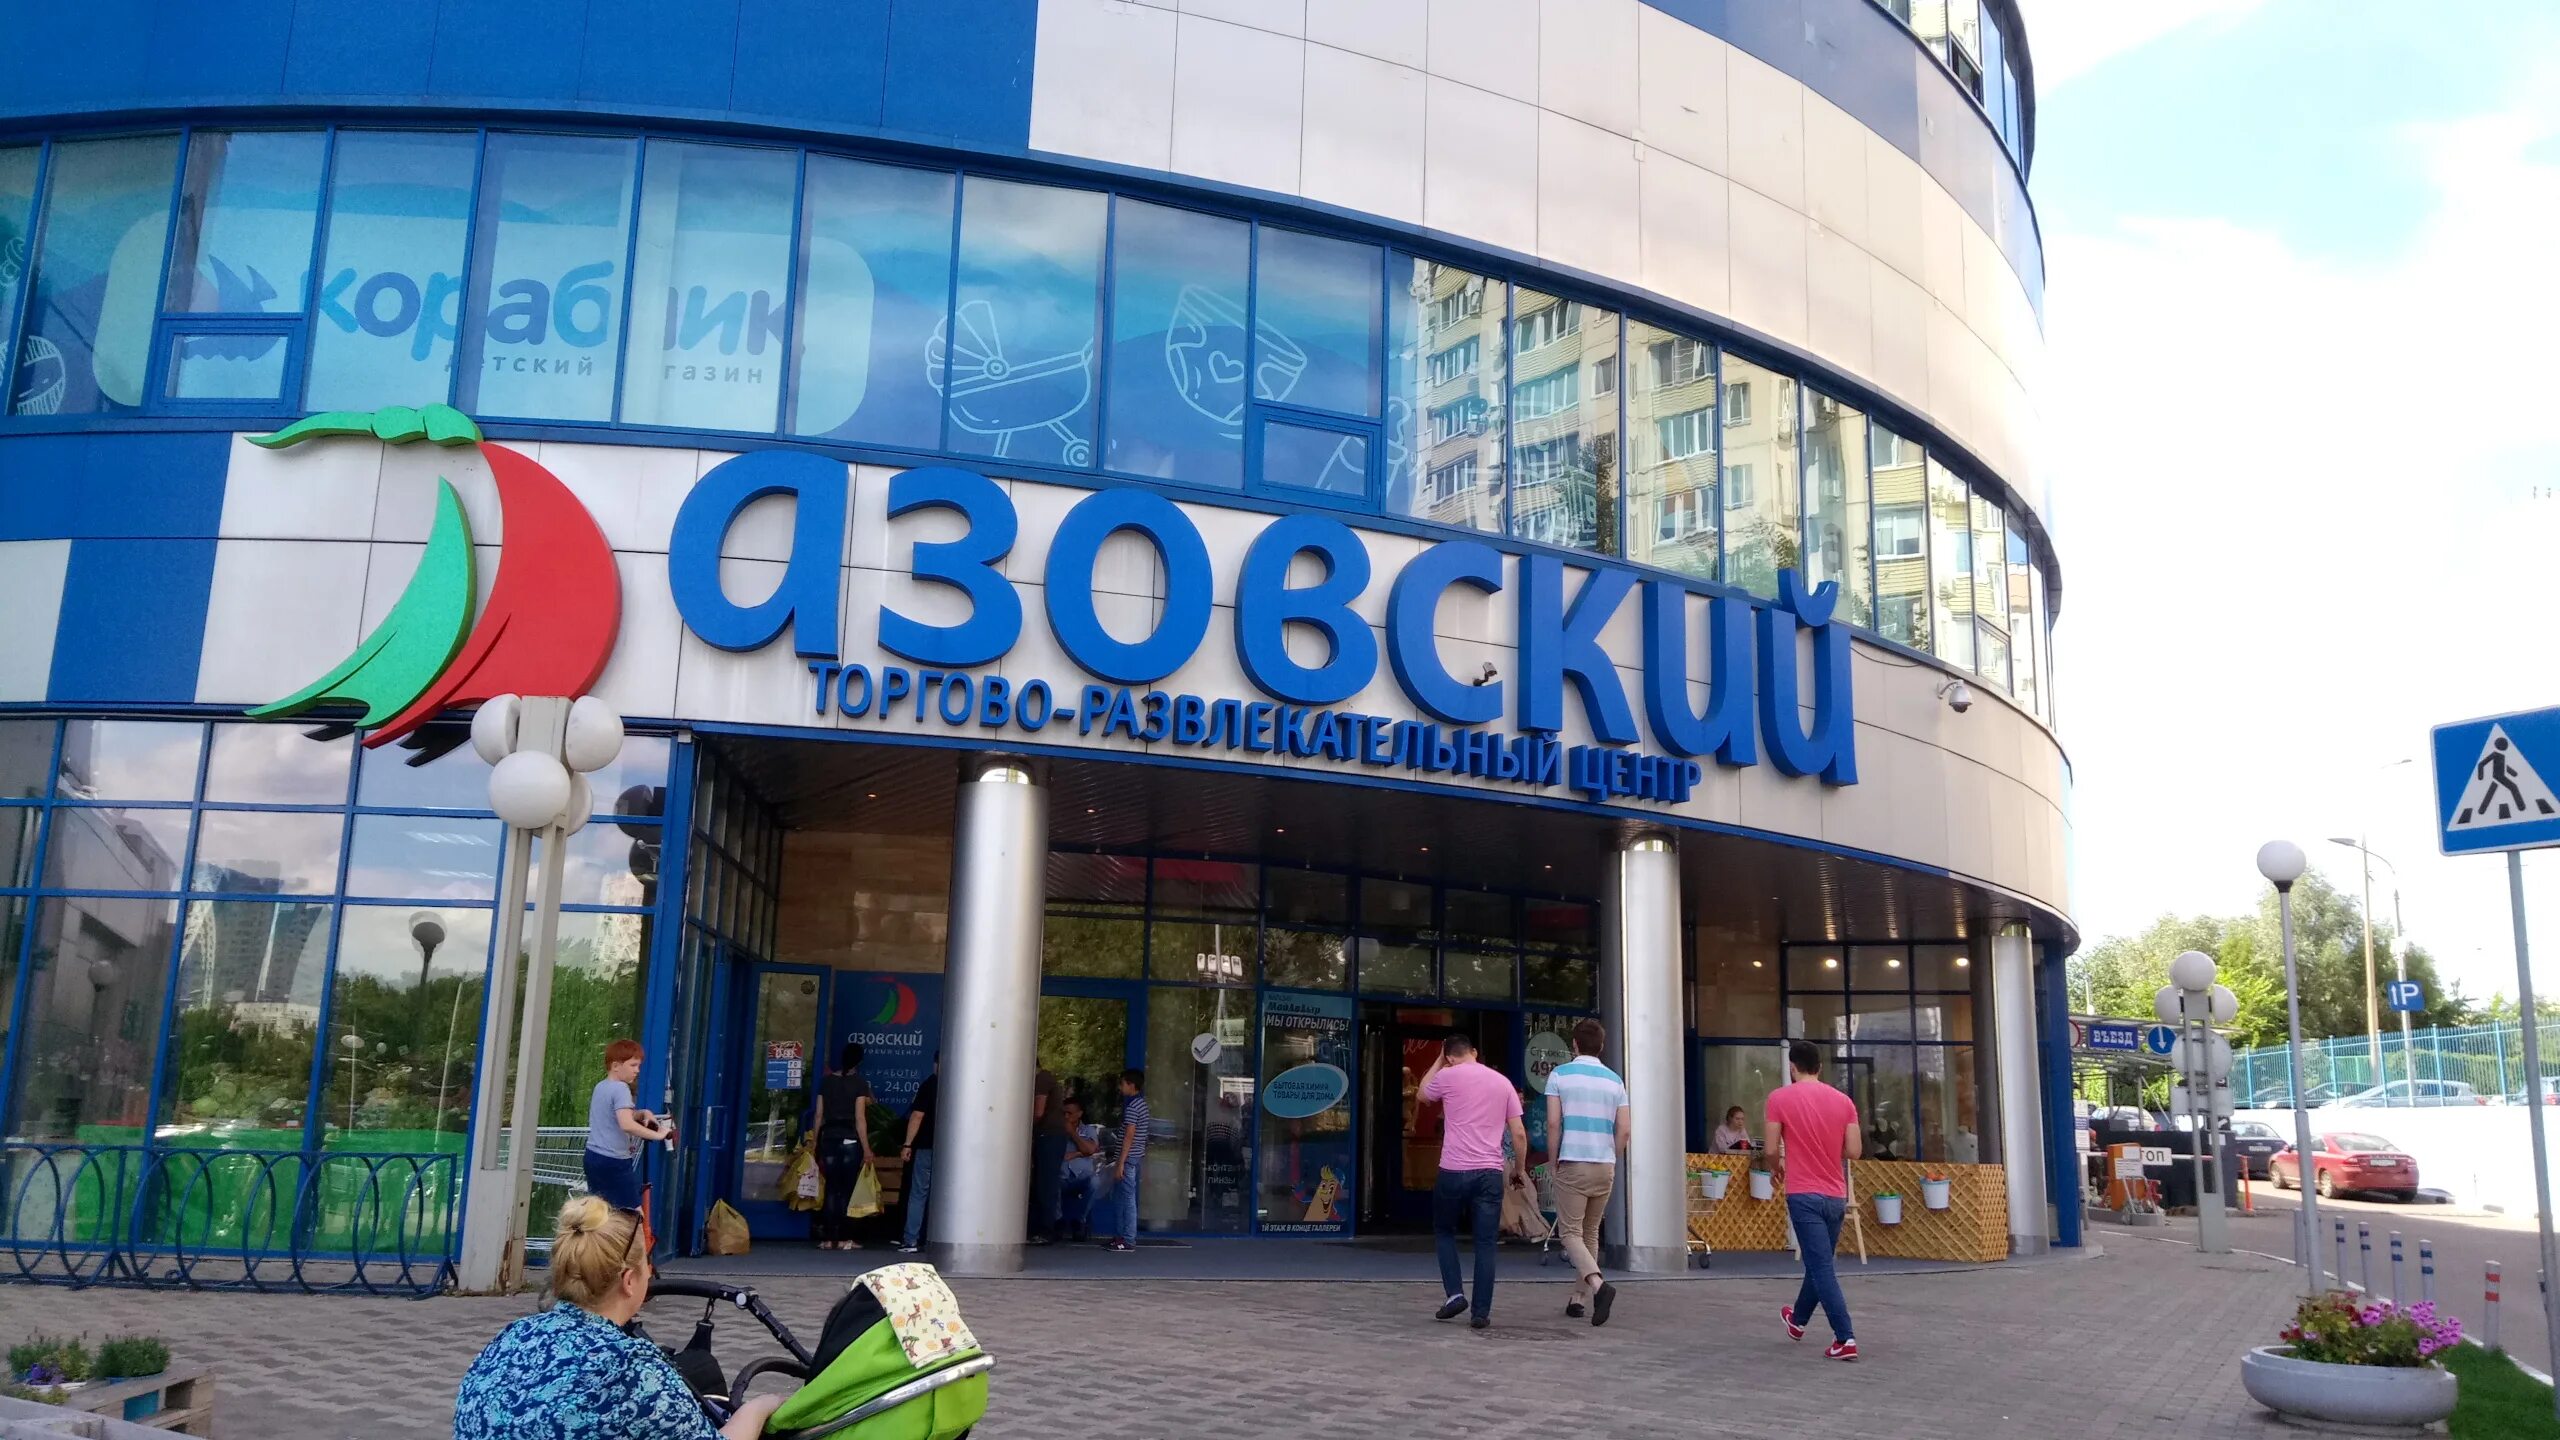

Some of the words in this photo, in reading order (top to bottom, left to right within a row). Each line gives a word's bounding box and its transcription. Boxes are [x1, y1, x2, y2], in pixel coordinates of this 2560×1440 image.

[444, 352, 594, 377] етский
[663, 363, 763, 384] газин
[807, 661, 1562, 787] ТОРГОВО-РАЗВЛЕКАТЕЛЬНЫЙ
[1569, 745, 1702, 805] ЦЕНТР
[1266, 1014, 1283, 1027] МЫ
[1286, 1015, 1349, 1031] ОТКРЫЛИСЬ!
[2093, 1029, 2134, 1046] ВЪЕЗД
